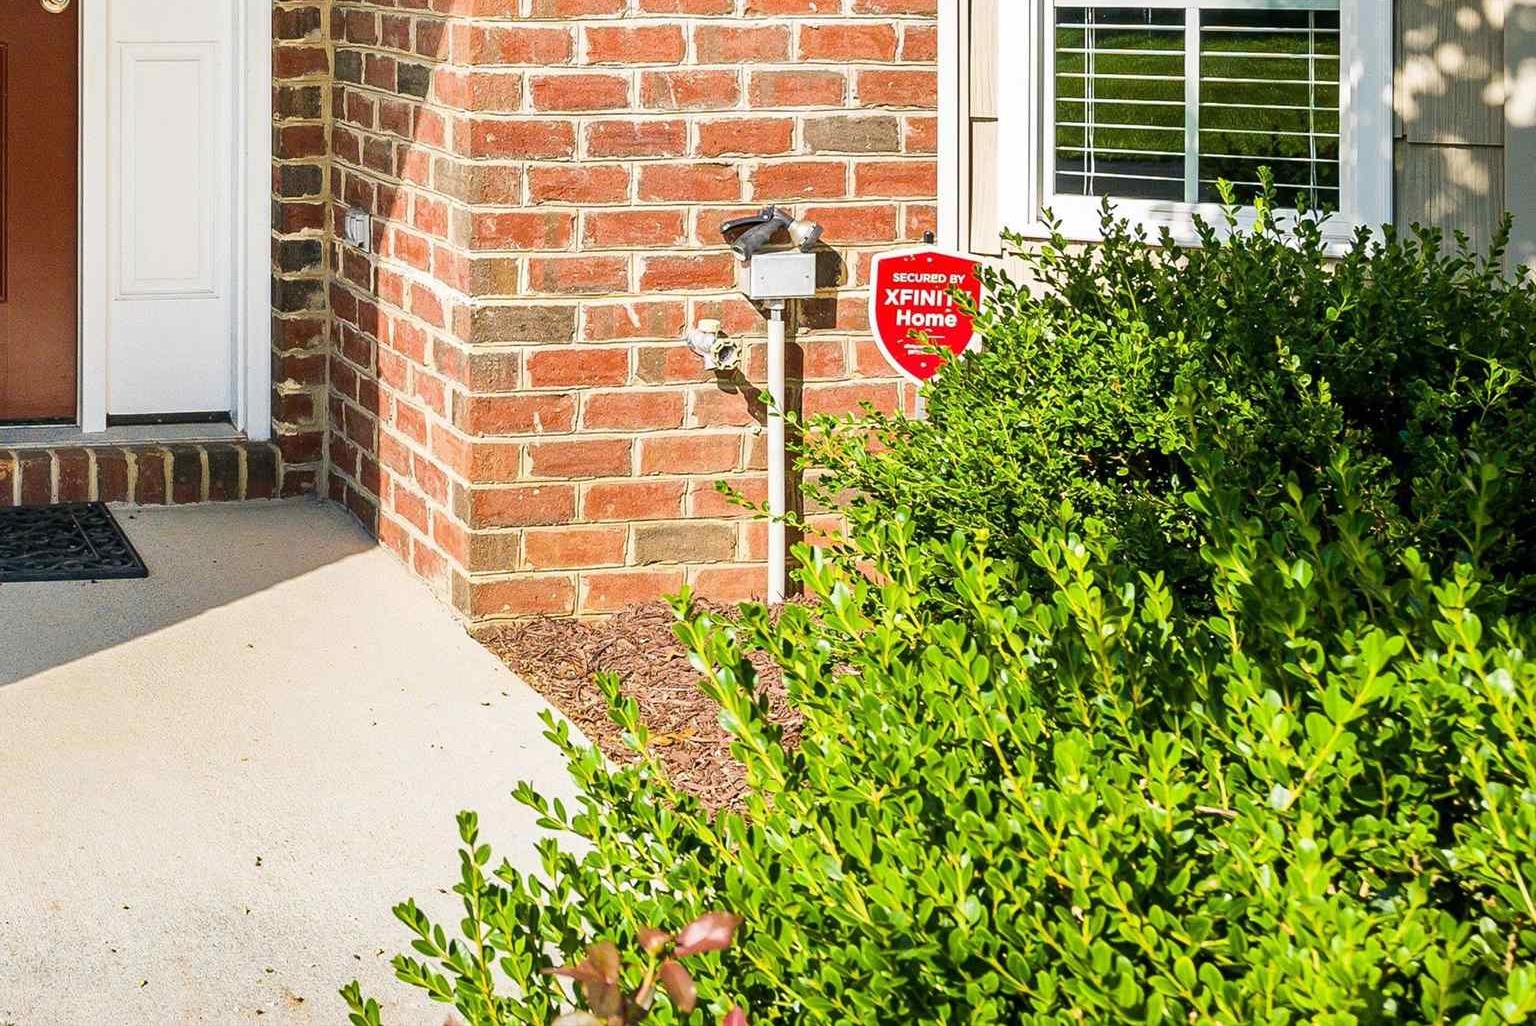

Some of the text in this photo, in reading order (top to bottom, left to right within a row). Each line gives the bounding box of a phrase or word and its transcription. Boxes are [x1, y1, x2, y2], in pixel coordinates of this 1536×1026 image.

[893, 273, 965, 284] SECURED BY
[884, 288, 972, 307] XFINIT
[896, 309, 958, 327] Home
